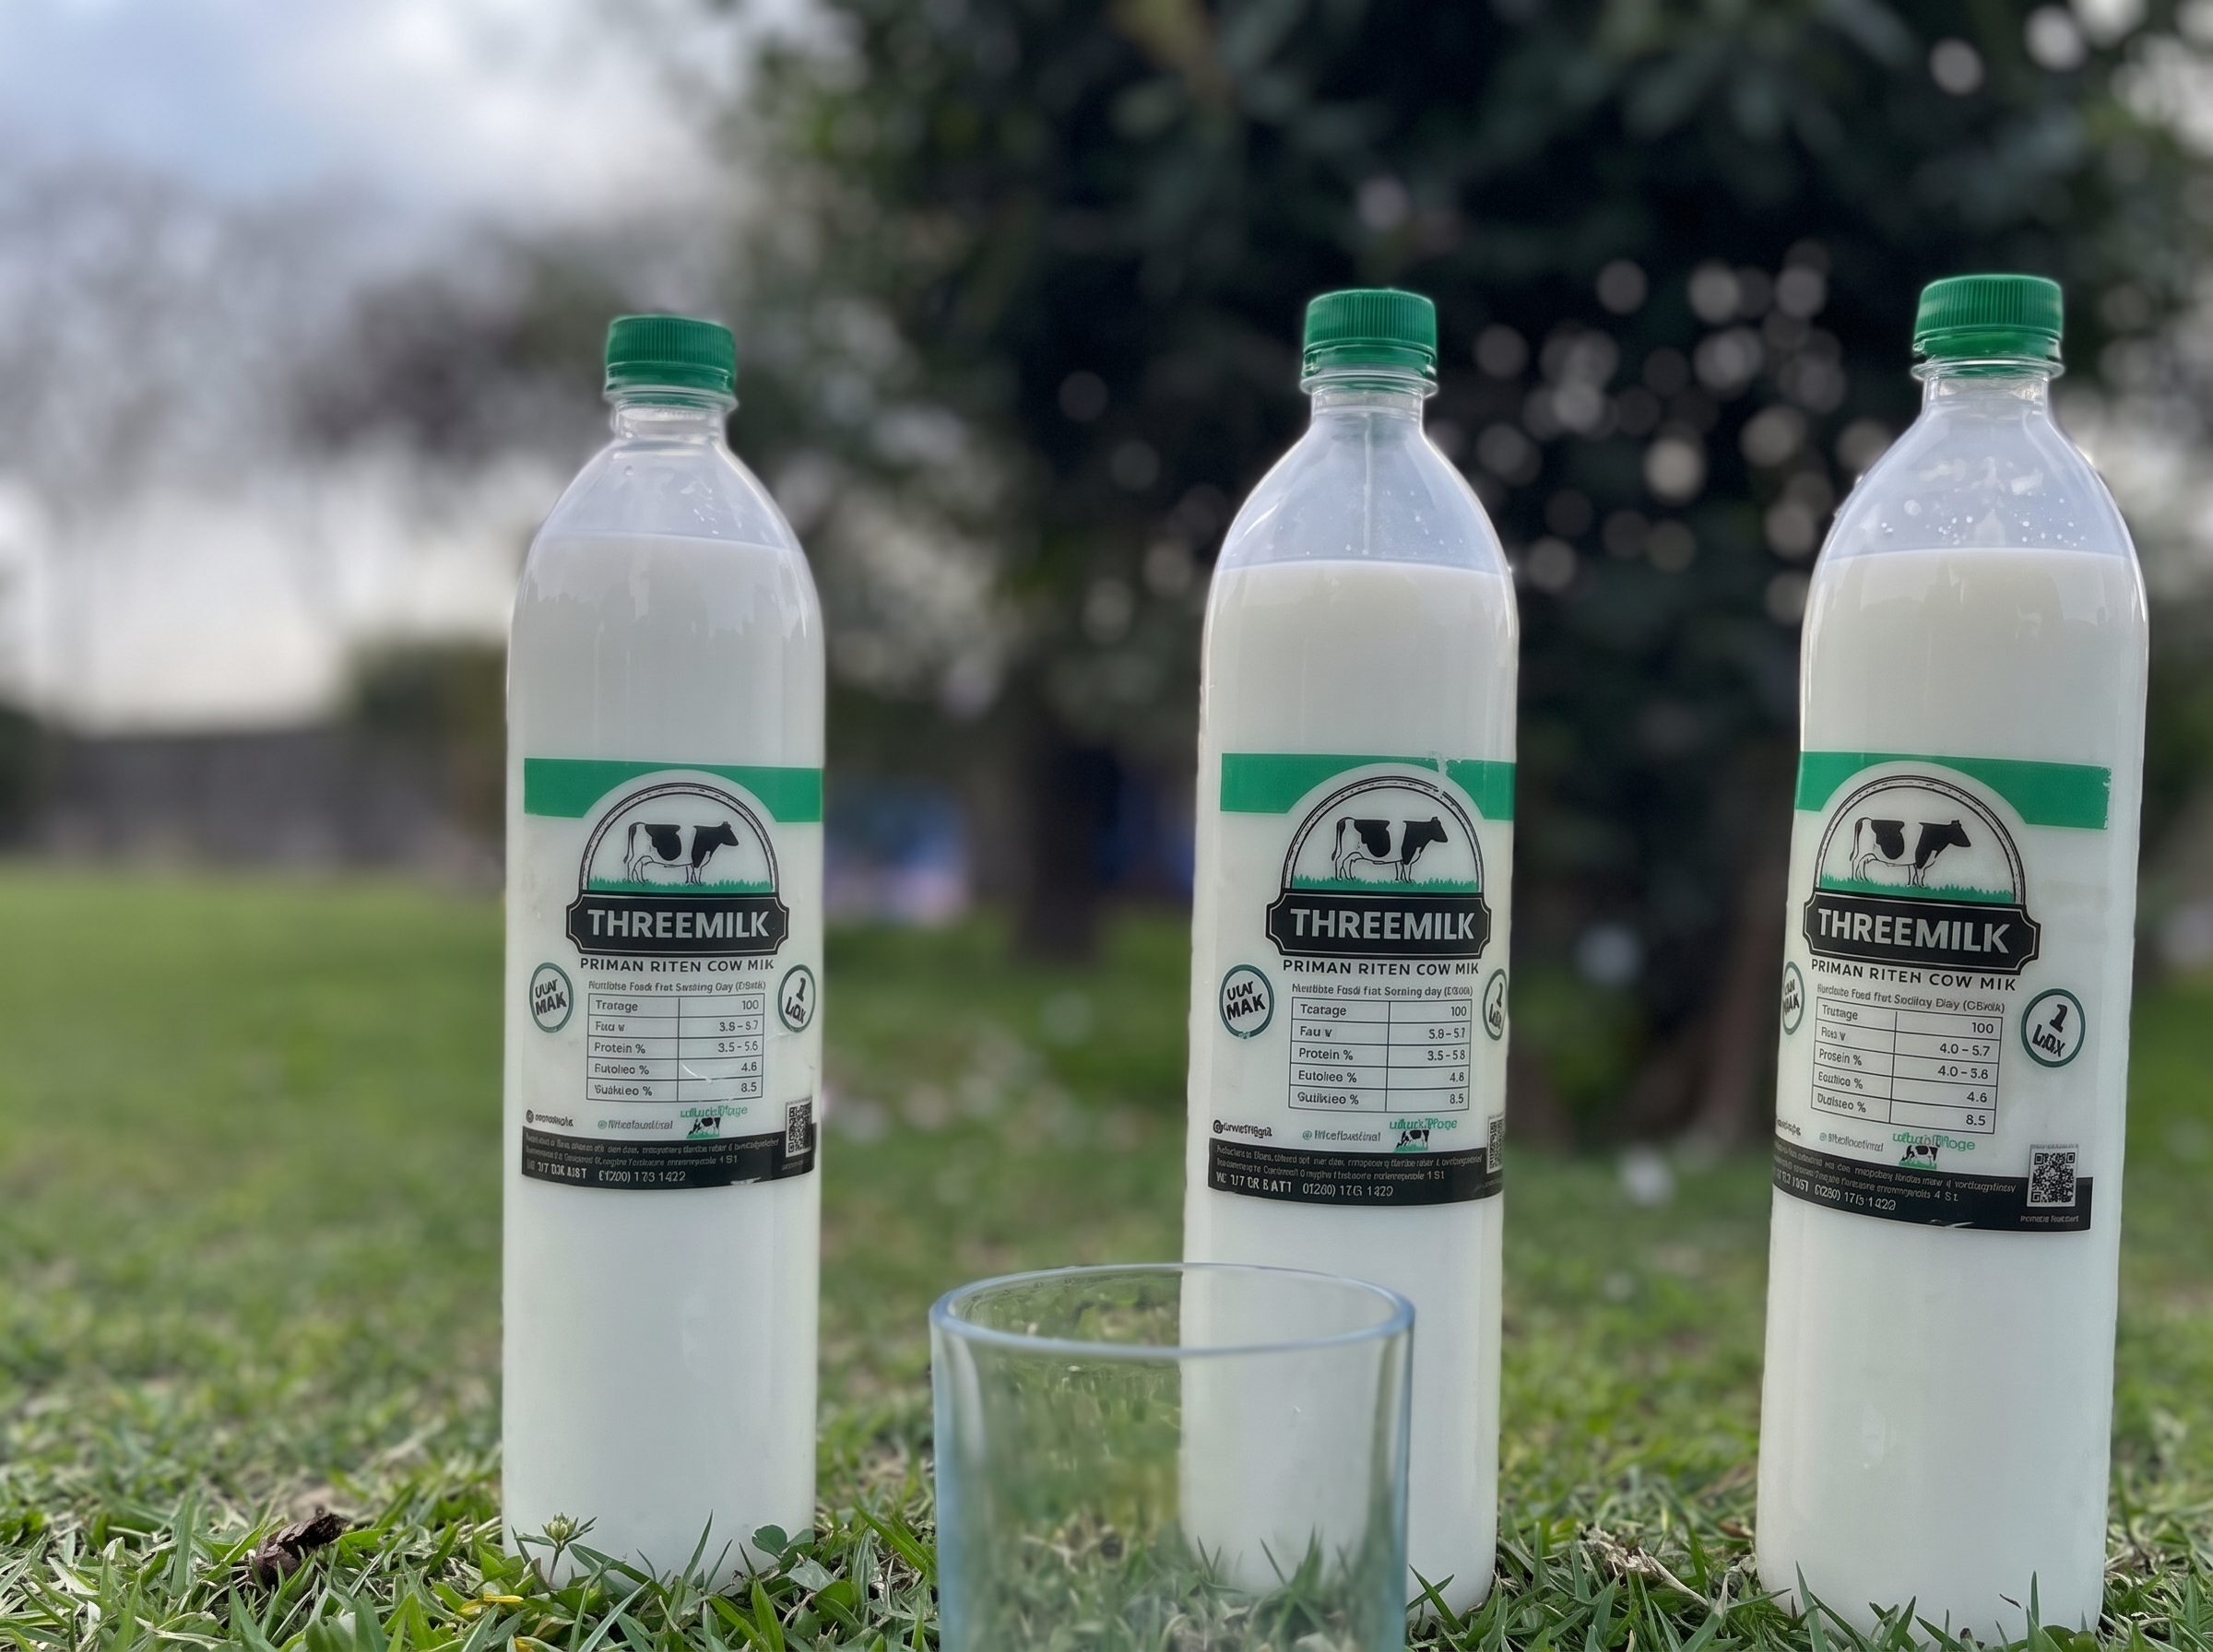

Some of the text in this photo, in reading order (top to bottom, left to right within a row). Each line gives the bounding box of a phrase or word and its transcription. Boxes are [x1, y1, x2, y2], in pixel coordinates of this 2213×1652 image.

[586, 909, 770, 938] THREEMILK
[1290, 908, 1474, 940] THREEMILK
[1817, 908, 2010, 954] THREEMILK
[580, 958, 775, 973] PRIMAN RITEN COW MIK
[1284, 959, 1479, 975] PRIMAN RITEN COW MIK
[1811, 959, 2016, 991] PRIMAN RITEN COW MIK
[1425, 986, 1442, 998] day
[535, 991, 567, 1016] MAK
[741, 999, 759, 1010] 100
[1226, 993, 1266, 1021] MAK
[1450, 1006, 1467, 1017] 100
[1971, 1022, 1994, 1034] 100
[594, 1043, 632, 1055] Protein
[635, 1044, 645, 1055] %
[717, 1042, 734, 1053] 3.5
[744, 1041, 758, 1051] 5.6
[1298, 1047, 1340, 1060] Protein
[1343, 1050, 1354, 1060] %
[1427, 1050, 1444, 1061] 3.5
[1939, 1044, 1959, 1055] 4.0
[1971, 1045, 1990, 1056] 5.7
[639, 1065, 649, 1075] %
[1852, 1055, 1863, 1066] %
[1937, 1065, 1959, 1077] 4.0
[1346, 1072, 1357, 1082] %
[642, 1086, 653, 1096] %
[1853, 1079, 1863, 1090] %
[1966, 1092, 1987, 1103] 4.6
[1349, 1094, 1359, 1104] %
[1450, 1093, 1464, 1103] 8.5
[1857, 1102, 1866, 1113] %
[1966, 1115, 1986, 1127] 8.5
